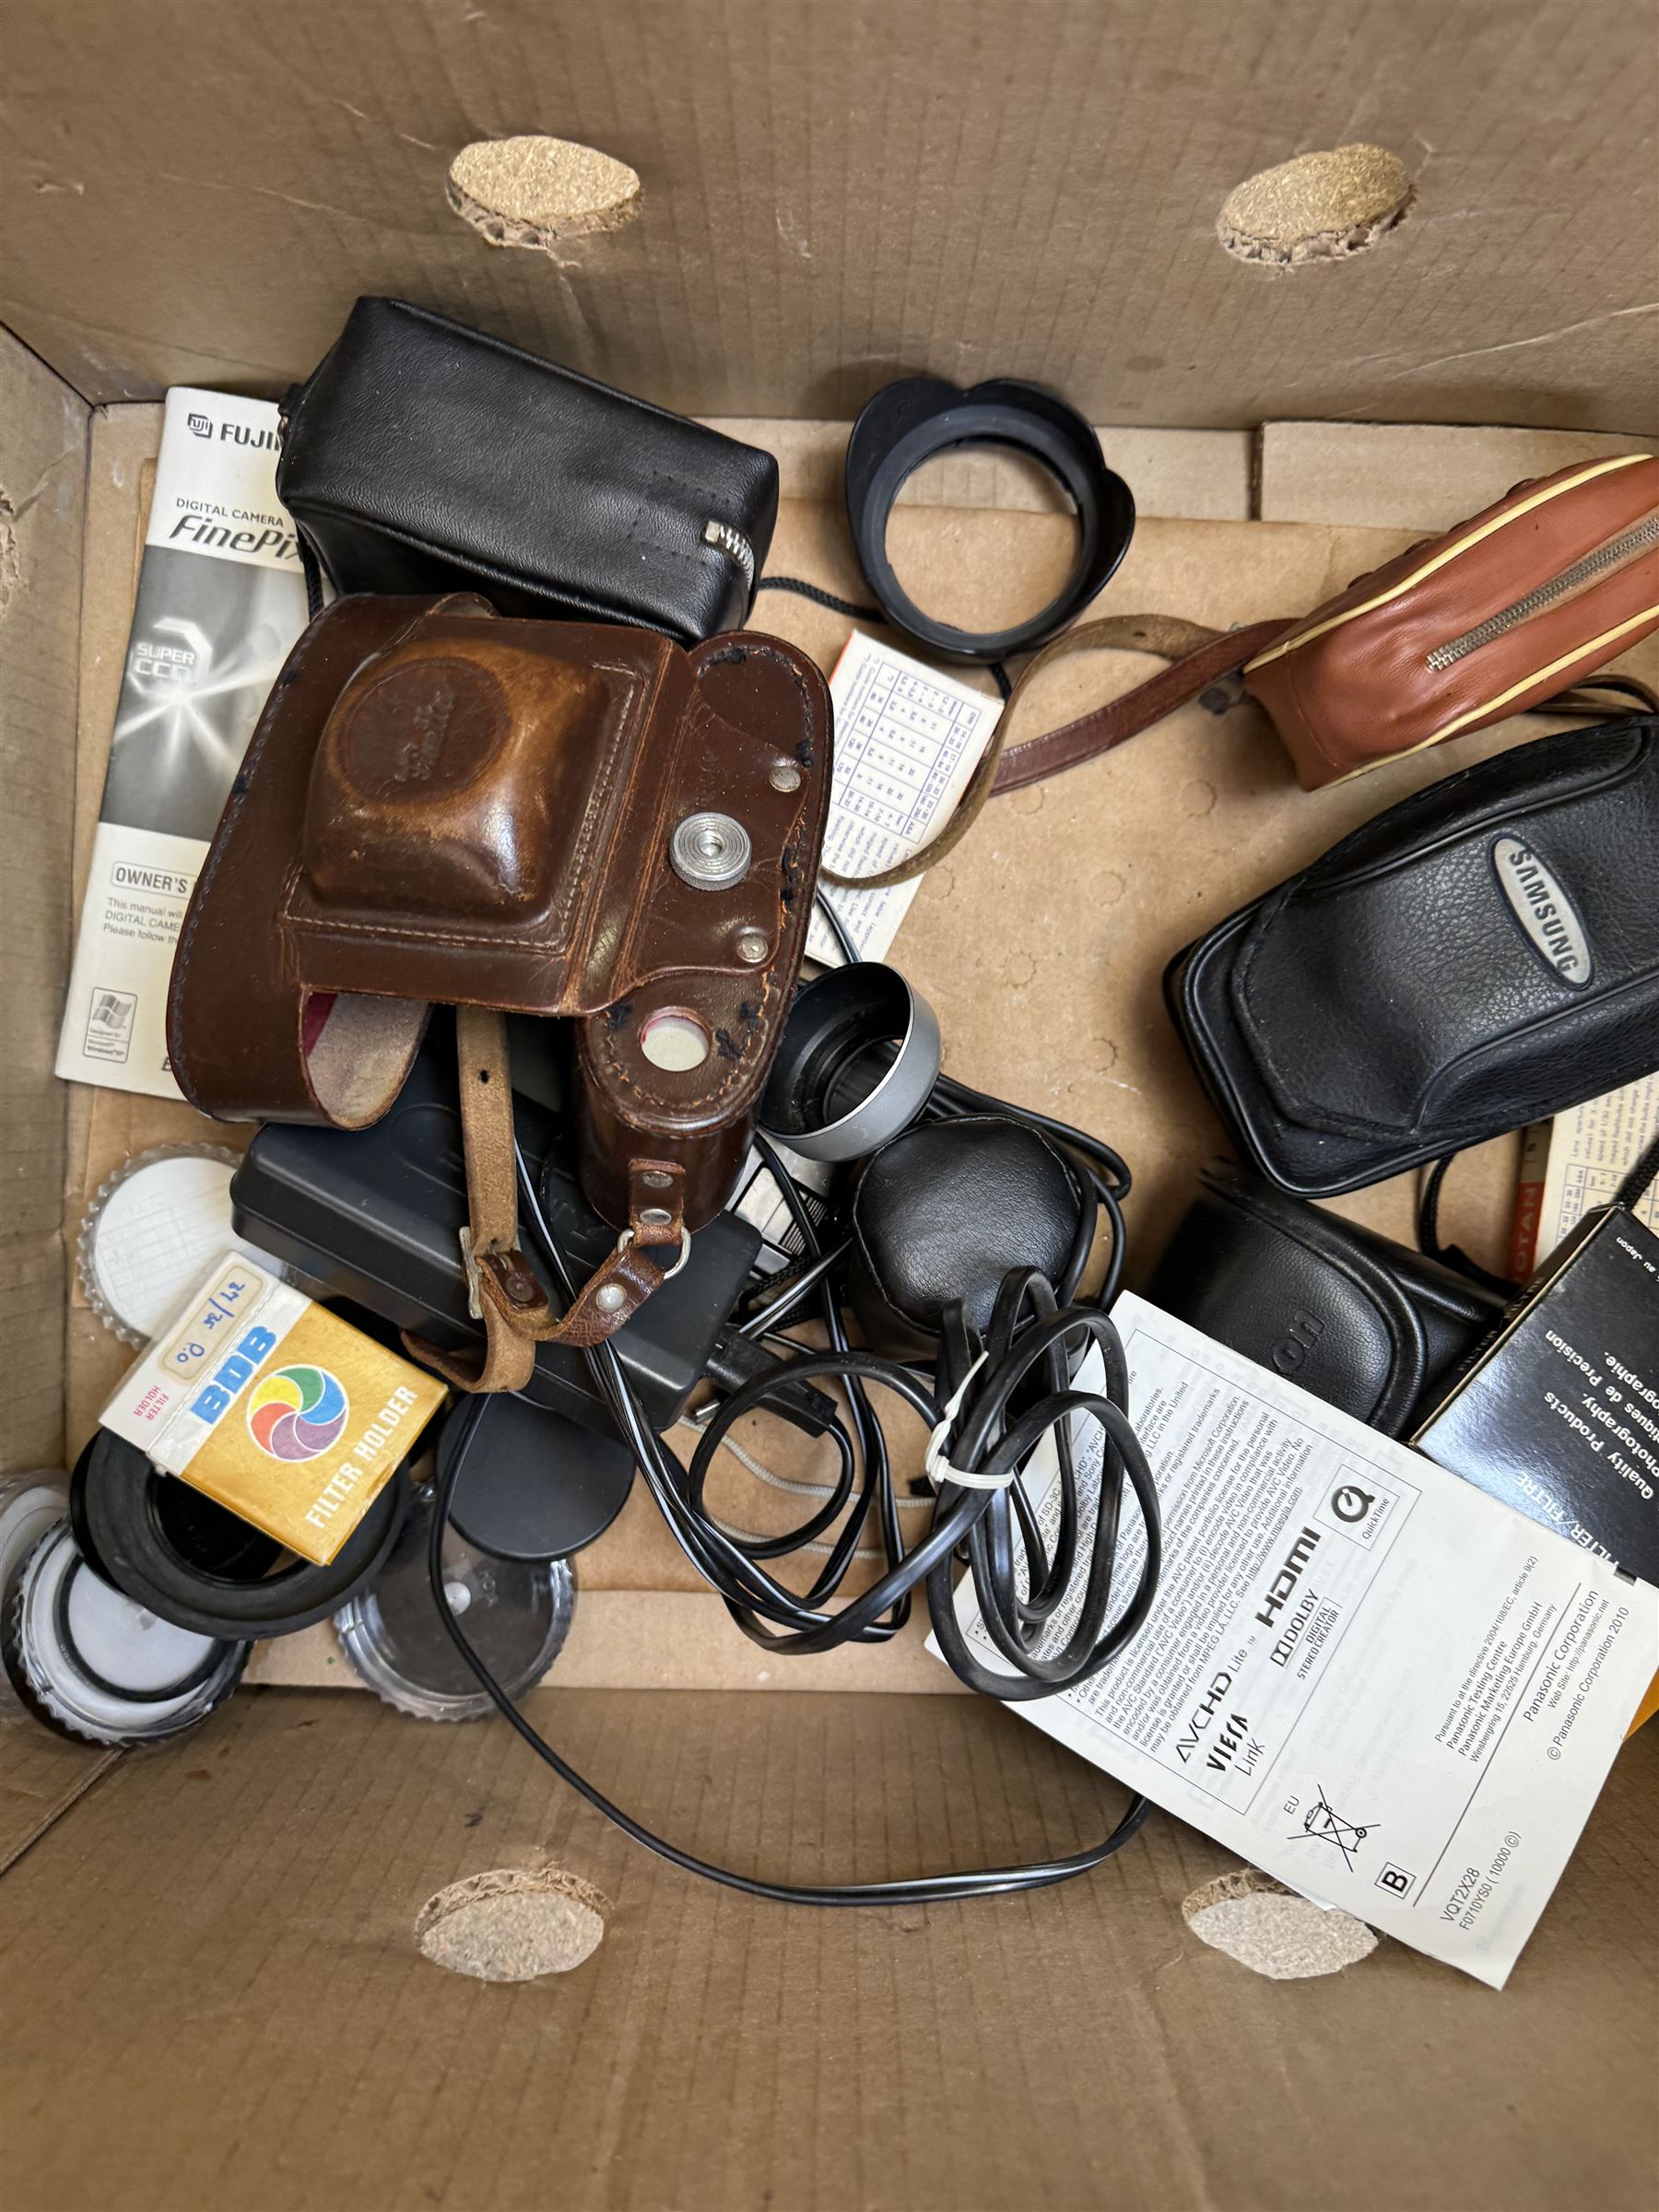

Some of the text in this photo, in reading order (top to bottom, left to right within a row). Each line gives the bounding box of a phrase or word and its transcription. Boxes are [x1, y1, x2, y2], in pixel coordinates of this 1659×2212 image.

[176, 497, 284, 528] DIGITAL CAMERA
[135, 658, 193, 681] CCD
[137, 642, 195, 665] SUPER
[109, 897, 128, 910] This
[130, 902, 166, 916] manual
[116, 866, 188, 893] OWNER'S
[103, 923, 135, 937] Please
[137, 930, 165, 943] follow
[105, 910, 182, 933] DIGITAL CAME
[1509, 849, 1579, 972] SAMSUNG
[1616, 1236, 1642, 1261] Japon
[134, 1384, 161, 1418] HOLDER
[190, 1325, 276, 1426] BDB
[1545, 1329, 1659, 1444] tiques de Precision
[1604, 1351, 1659, 1410] ographie.
[146, 1394, 170, 1422] FILTER
[304, 1385, 418, 1529] FILTER HOLDER
[1544, 1392, 1654, 1500] Quality Products
[1360, 1497, 1390, 1540] QuickTime
[1095, 1698, 1111, 1717] This
[1106, 1665, 1130, 1700] product
[1128, 1621, 1153, 1657] licensed
[1147, 1596, 1167, 1622] under
[1162, 1582, 1175, 1597] the
[1170, 1561, 1186, 1583] AVC
[1181, 1535, 1203, 1563] patent
[1195, 1502, 1221, 1537] portfolio
[1214, 1473, 1235, 1503] license
[1230, 1460, 1242, 1475] for
[1237, 1446, 1250, 1461] the
[1244, 1411, 1271, 1449] personal
[1104, 1705, 1119, 1724] and
[1113, 1639, 1155, 1706] non-commercial
[1152, 1623, 1164, 1640] use
[1171, 1565, 1197, 1606] consumer
[1203, 1513, 1225, 1545] encode
[1220, 1490, 1238, 1514] video
[1238, 1436, 1270, 1483] compliance
[1264, 1418, 1277, 1436] with
[1113, 1713, 1126, 1729] the
[1121, 1694, 1137, 1714] AVC
[1133, 1655, 1159, 1694] Standard
[1185, 1571, 1205, 1599] and/or
[1206, 1528, 1230, 1559] decode
[1224, 1509, 1240, 1529] AVC
[1235, 1484, 1253, 1509] Video
[1249, 1467, 1263, 1485] that
[1260, 1450, 1273, 1468] was
[1510, 1571, 1529, 1595] article
[1523, 1555, 1538, 1572] 9(2)
[1140, 1716, 1161, 1747] license
[1161, 1674, 1186, 1708] granted
[1186, 1642, 1202, 1664] shall
[1205, 1600, 1228, 1631] implied
[1221, 1587, 1233, 1601] for
[1230, 1571, 1243, 1589] any
[1237, 1548, 1254, 1571] other
[1260, 1488, 1288, 1530] Additional
[1283, 1442, 1312, 1488] information
[1282, 1588, 1321, 1642] DOLBY
[1532, 1603, 1558, 1640] Germany
[1171, 1526, 1322, 1763] AVCHD Lite HDMI
[1296, 1609, 1339, 1679] STEREO CREATOR
[1304, 1604, 1331, 1642] DIGITAL
[1151, 1734, 1166, 1753] may
[1167, 1684, 1192, 1721] obtained
[1187, 1663, 1204, 1684] from
[1199, 1635, 1219, 1664] MPEG
[1235, 1579, 1250, 1597] See
[1455, 1600, 1543, 1756] Panasonic Marketing Europe GmbH
[1466, 1644, 1490, 1677] directive
[1519, 1588, 1602, 1722] Panasonic Corporation
[1547, 1598, 1612, 1709] Web Site: http://panasonic.net
[1550, 1691, 1588, 1746] Panasonic
[1576, 1633, 1618, 1694] Corporation
[1607, 1606, 1630, 1634] 2010
[1443, 1640, 1508, 1748] Panasonic Testing Centre
[1460, 1677, 1473, 1690] the
[1433, 1707, 1458, 1742] Pursuant
[1282, 1794, 1300, 1814] EU
[1381, 1867, 1409, 1893] B
[1440, 1865, 1481, 1924] VQT2X28
[1459, 1881, 1493, 1931] F0710YS0
[1488, 1846, 1512, 1877] 10000
